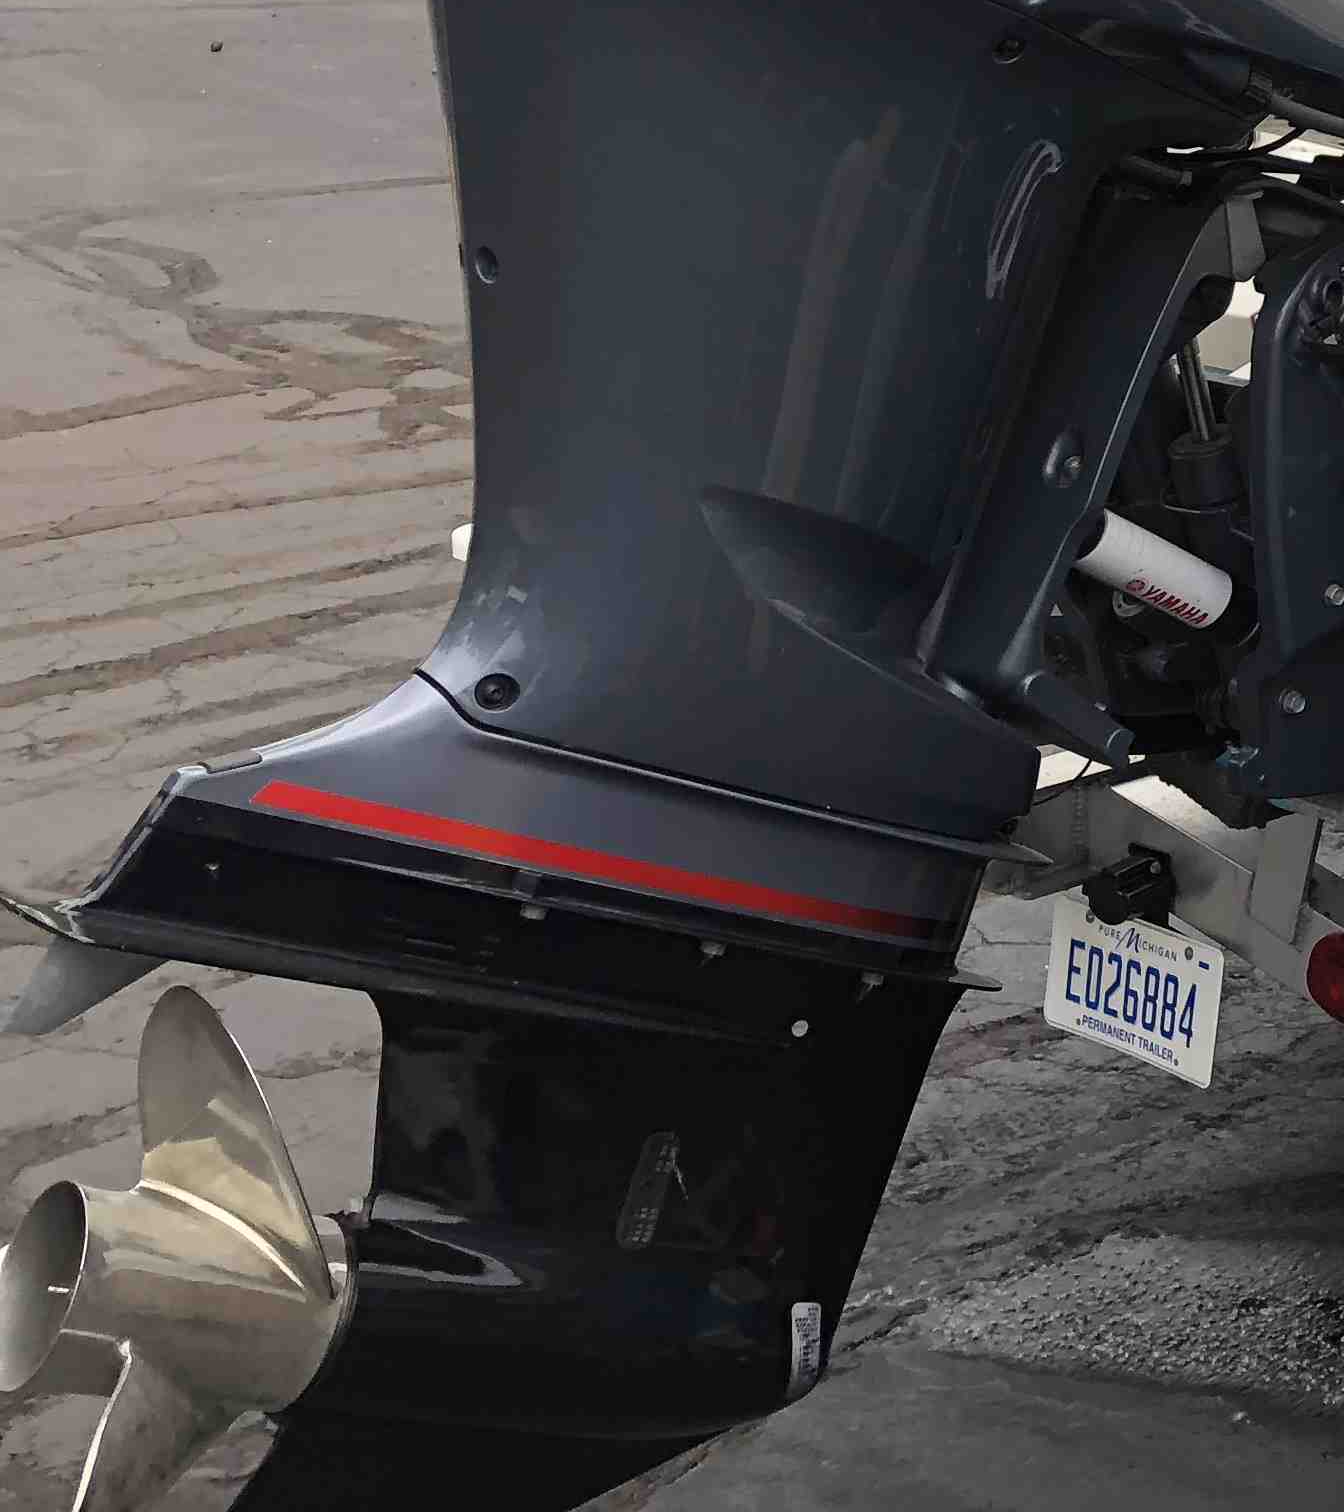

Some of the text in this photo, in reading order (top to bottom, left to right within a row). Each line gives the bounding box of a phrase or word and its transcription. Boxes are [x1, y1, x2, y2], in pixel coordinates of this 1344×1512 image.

[1142, 585, 1209, 625] YAMAHA
[1098, 924, 1121, 940] PURE
[1065, 938, 1198, 1049] E026884
[1081, 1014, 1174, 1063] PERMANENT TRAILER
